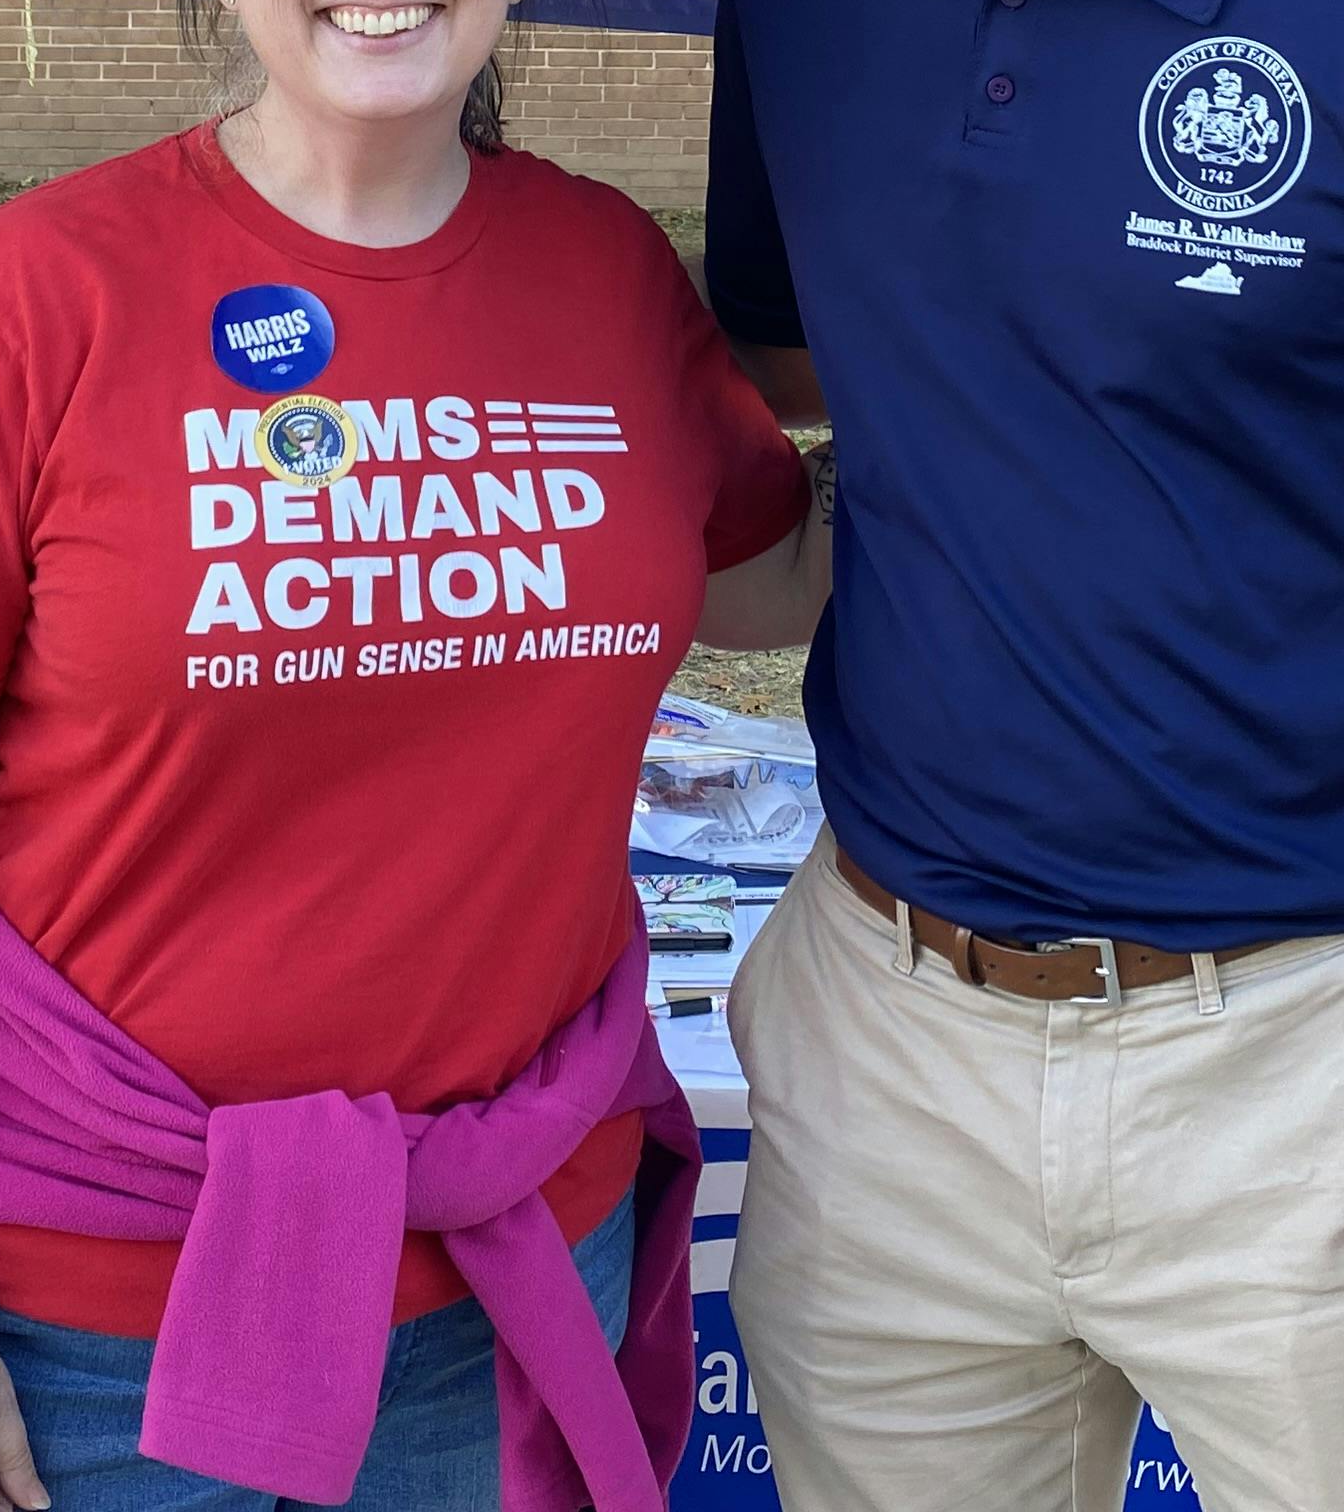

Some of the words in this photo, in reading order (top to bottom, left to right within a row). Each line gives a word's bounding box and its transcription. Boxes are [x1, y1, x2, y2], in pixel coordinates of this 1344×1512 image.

[1158, 44, 1219, 90] COUNTY
[1222, 43, 1247, 57] OF
[1246, 45, 1301, 107] FAIRFAX
[1176, 180, 1256, 211] VIRGINIA
[1200, 168, 1234, 185] 1742
[1125, 211, 1176, 235] James
[1179, 219, 1198, 238] R.
[1202, 221, 1306, 252] Walkinshaw
[1126, 232, 1183, 255] Braddock
[1184, 242, 1232, 262] District
[1233, 248, 1304, 268] Supervisor
[225, 308, 311, 350] HARRIS
[246, 337, 305, 363] WALZ
[308, 397, 346, 422] ELECTION
[184, 396, 481, 474] MMS
[302, 475, 332, 486] 2024
[190, 469, 606, 550] DEMAND
[185, 543, 567, 635] ACTION
[187, 655, 258, 690] FOR
[274, 647, 344, 686] GUN
[356, 637, 464, 678] SENSE
[473, 632, 507, 666] IN
[515, 622, 662, 663] AMERICA
